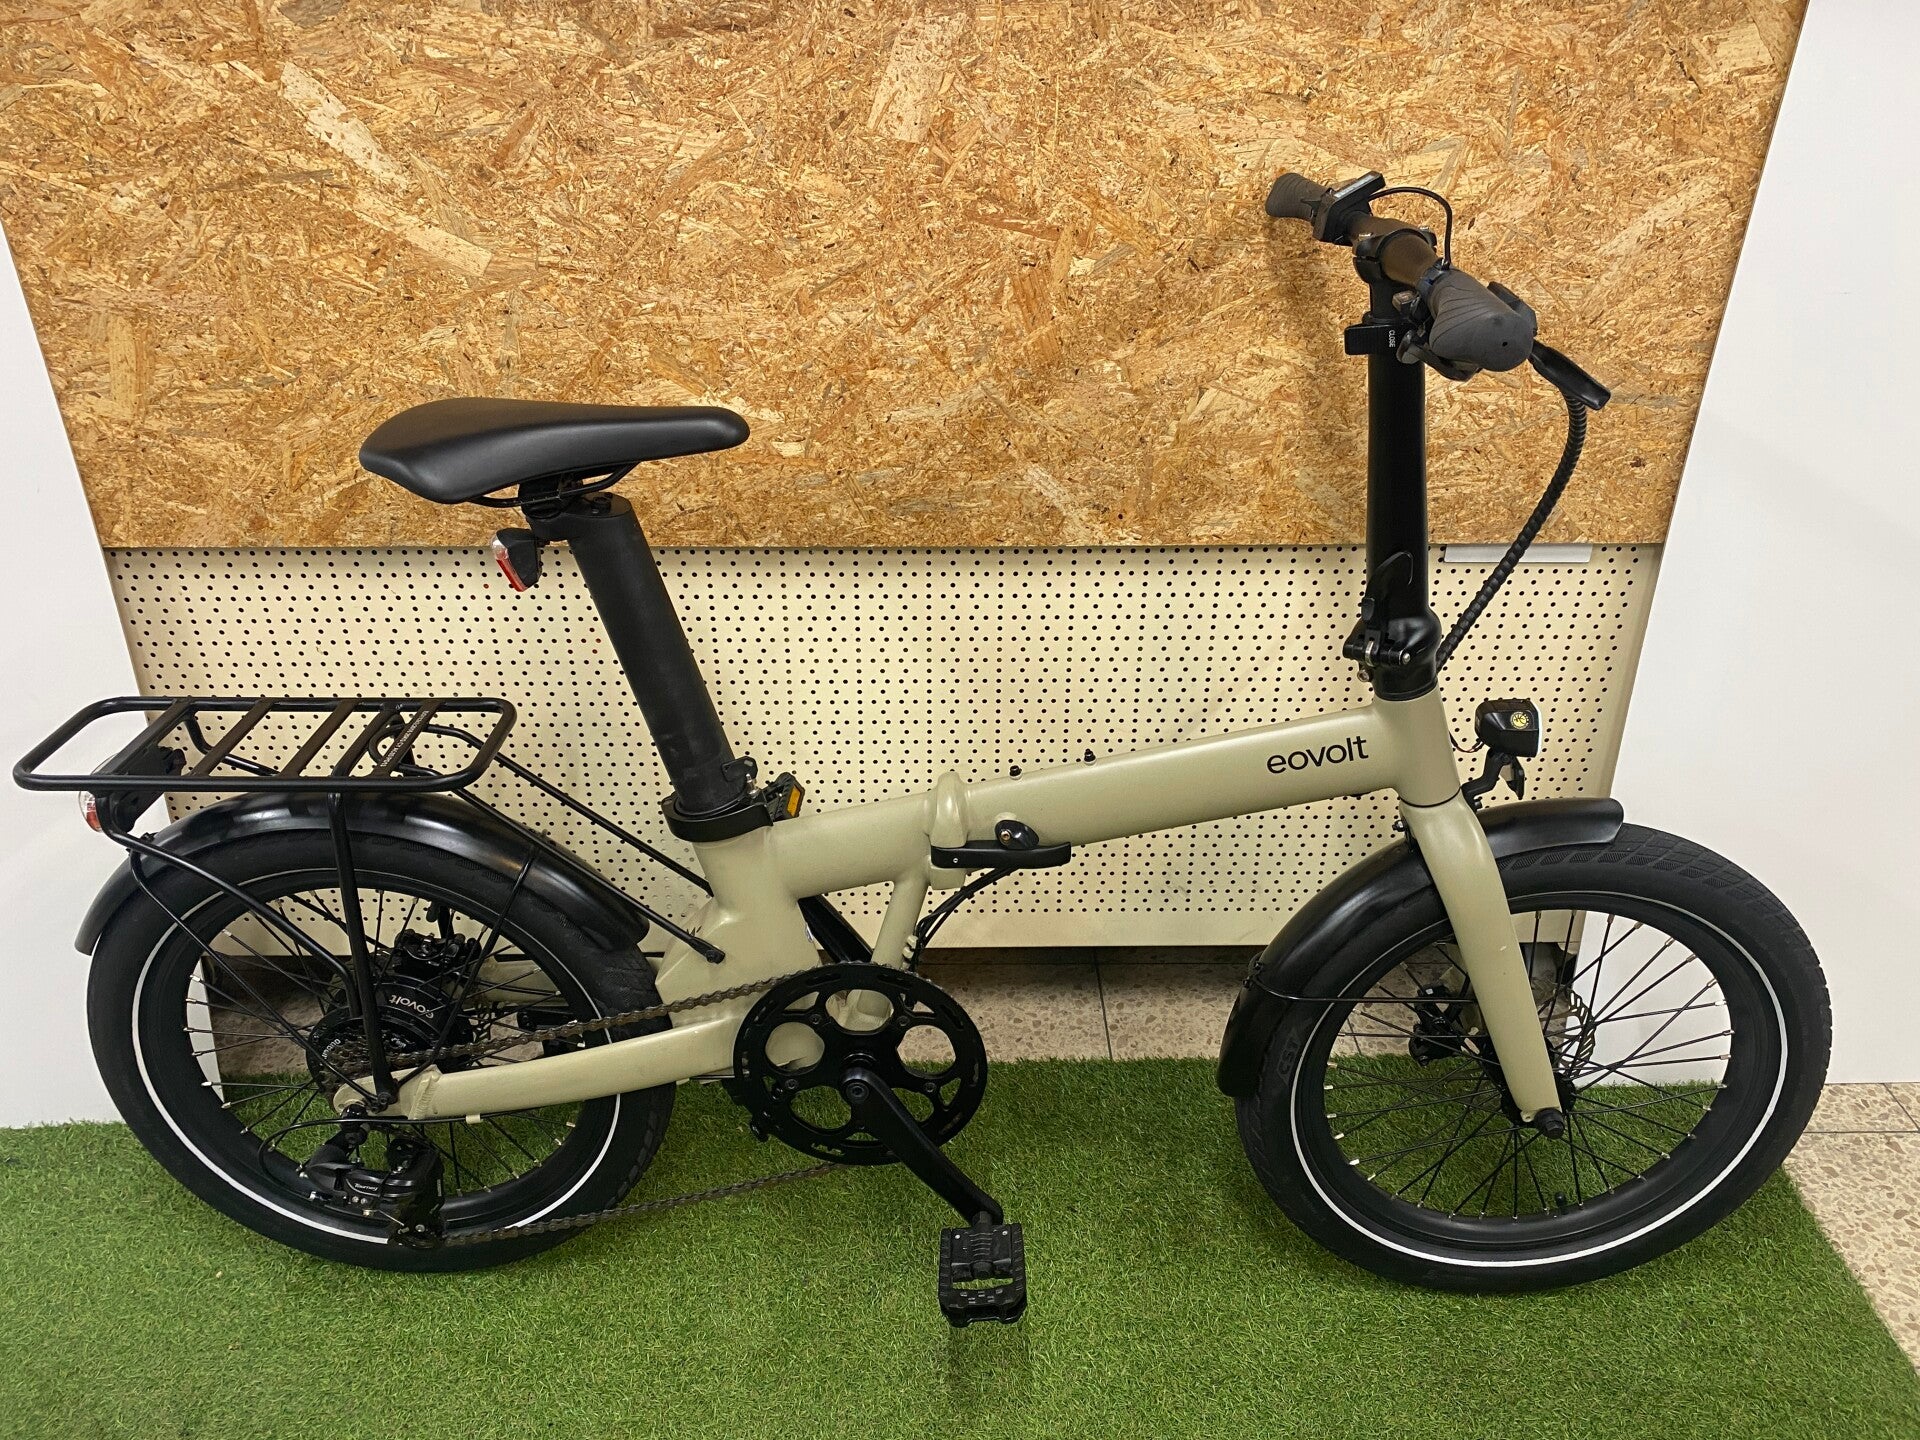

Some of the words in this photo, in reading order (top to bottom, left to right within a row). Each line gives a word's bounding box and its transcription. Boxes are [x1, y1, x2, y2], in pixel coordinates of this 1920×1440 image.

[1388, 329, 1396, 348] CLOSE
[1266, 735, 1369, 774] eovolt
[354, 1182, 379, 1192] Tourney
